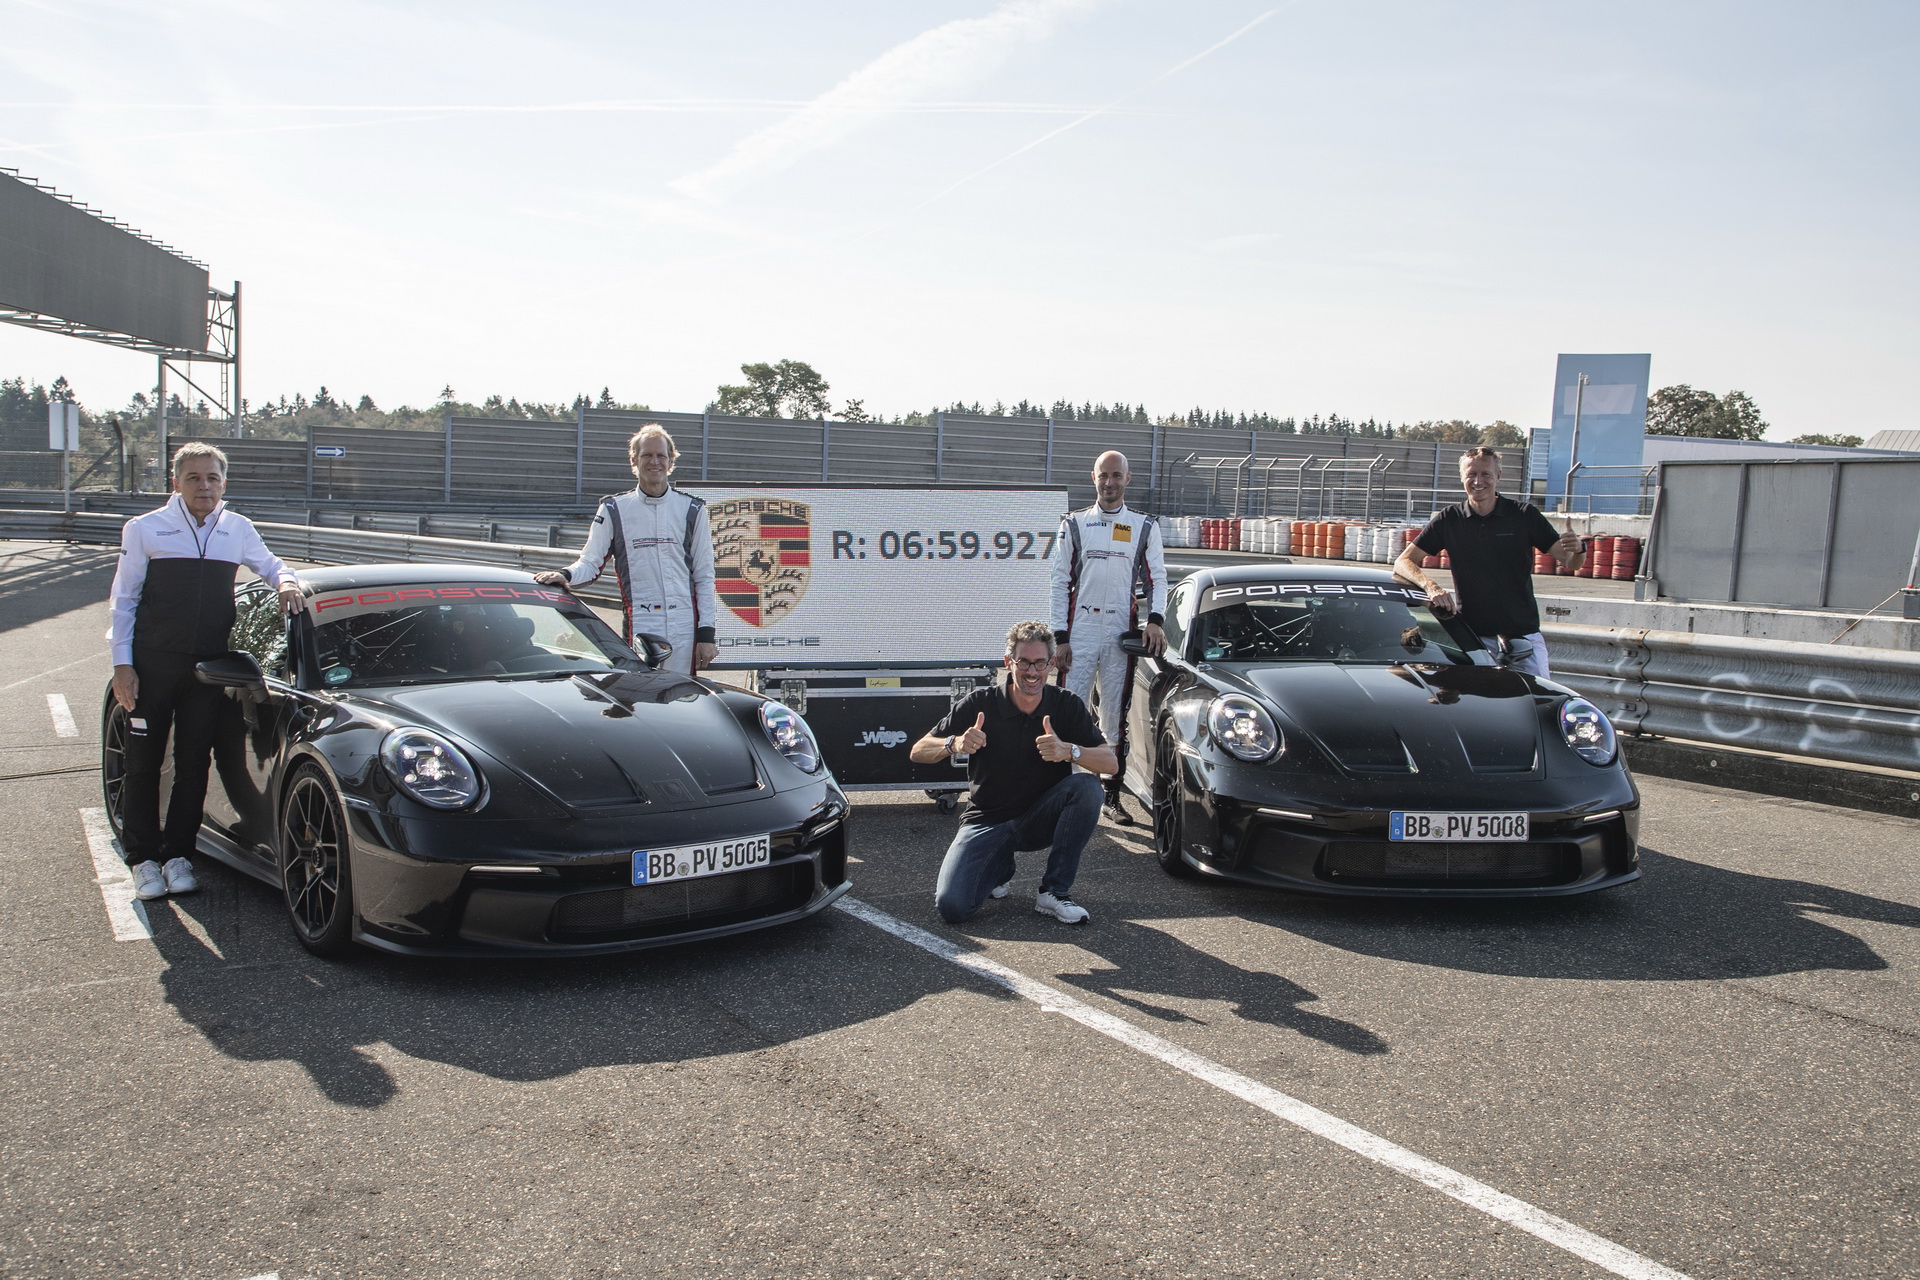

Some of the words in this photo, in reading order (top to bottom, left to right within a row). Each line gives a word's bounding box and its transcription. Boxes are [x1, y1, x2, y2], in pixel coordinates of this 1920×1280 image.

[709, 501, 807, 520] PORSCHE
[832, 530, 866, 559] R:
[879, 530, 1057, 559] 06:59.927
[314, 587, 577, 613] PORSCHE
[1211, 584, 1431, 601] PORSCHE
[716, 637, 820, 647] ORSCHE
[1405, 815, 1431, 838] BB
[1447, 816, 1473, 838] PV
[1477, 815, 1526, 838] 5008
[649, 853, 676, 879] BB
[693, 847, 718, 873] PV
[722, 839, 767, 868] 5005
